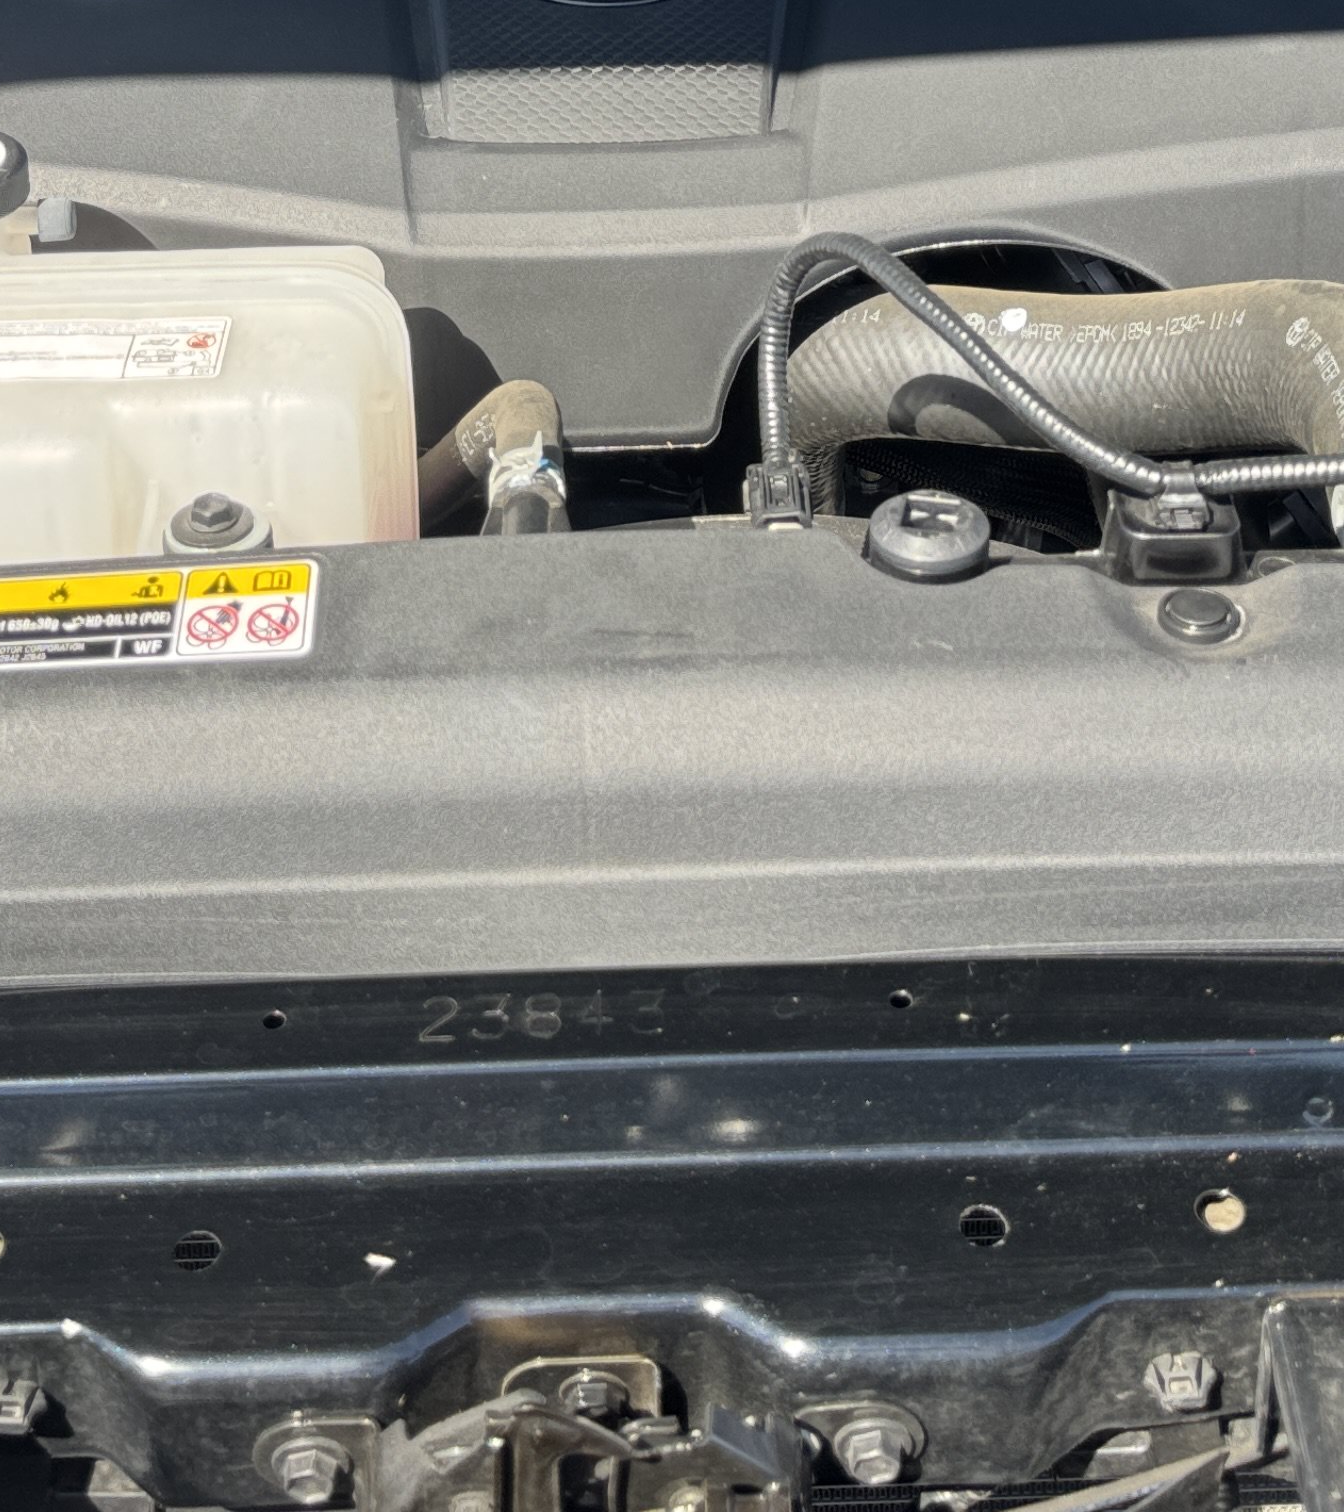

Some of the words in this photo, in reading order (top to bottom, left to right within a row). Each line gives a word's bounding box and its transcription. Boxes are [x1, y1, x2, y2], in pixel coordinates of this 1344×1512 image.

[1020, 321, 1064, 343] WATER
[139, 610, 172, 627] (POE)
[24, 642, 86, 654] CORPORATION
[133, 639, 163, 654] WF
[418, 987, 666, 1044] 23843
